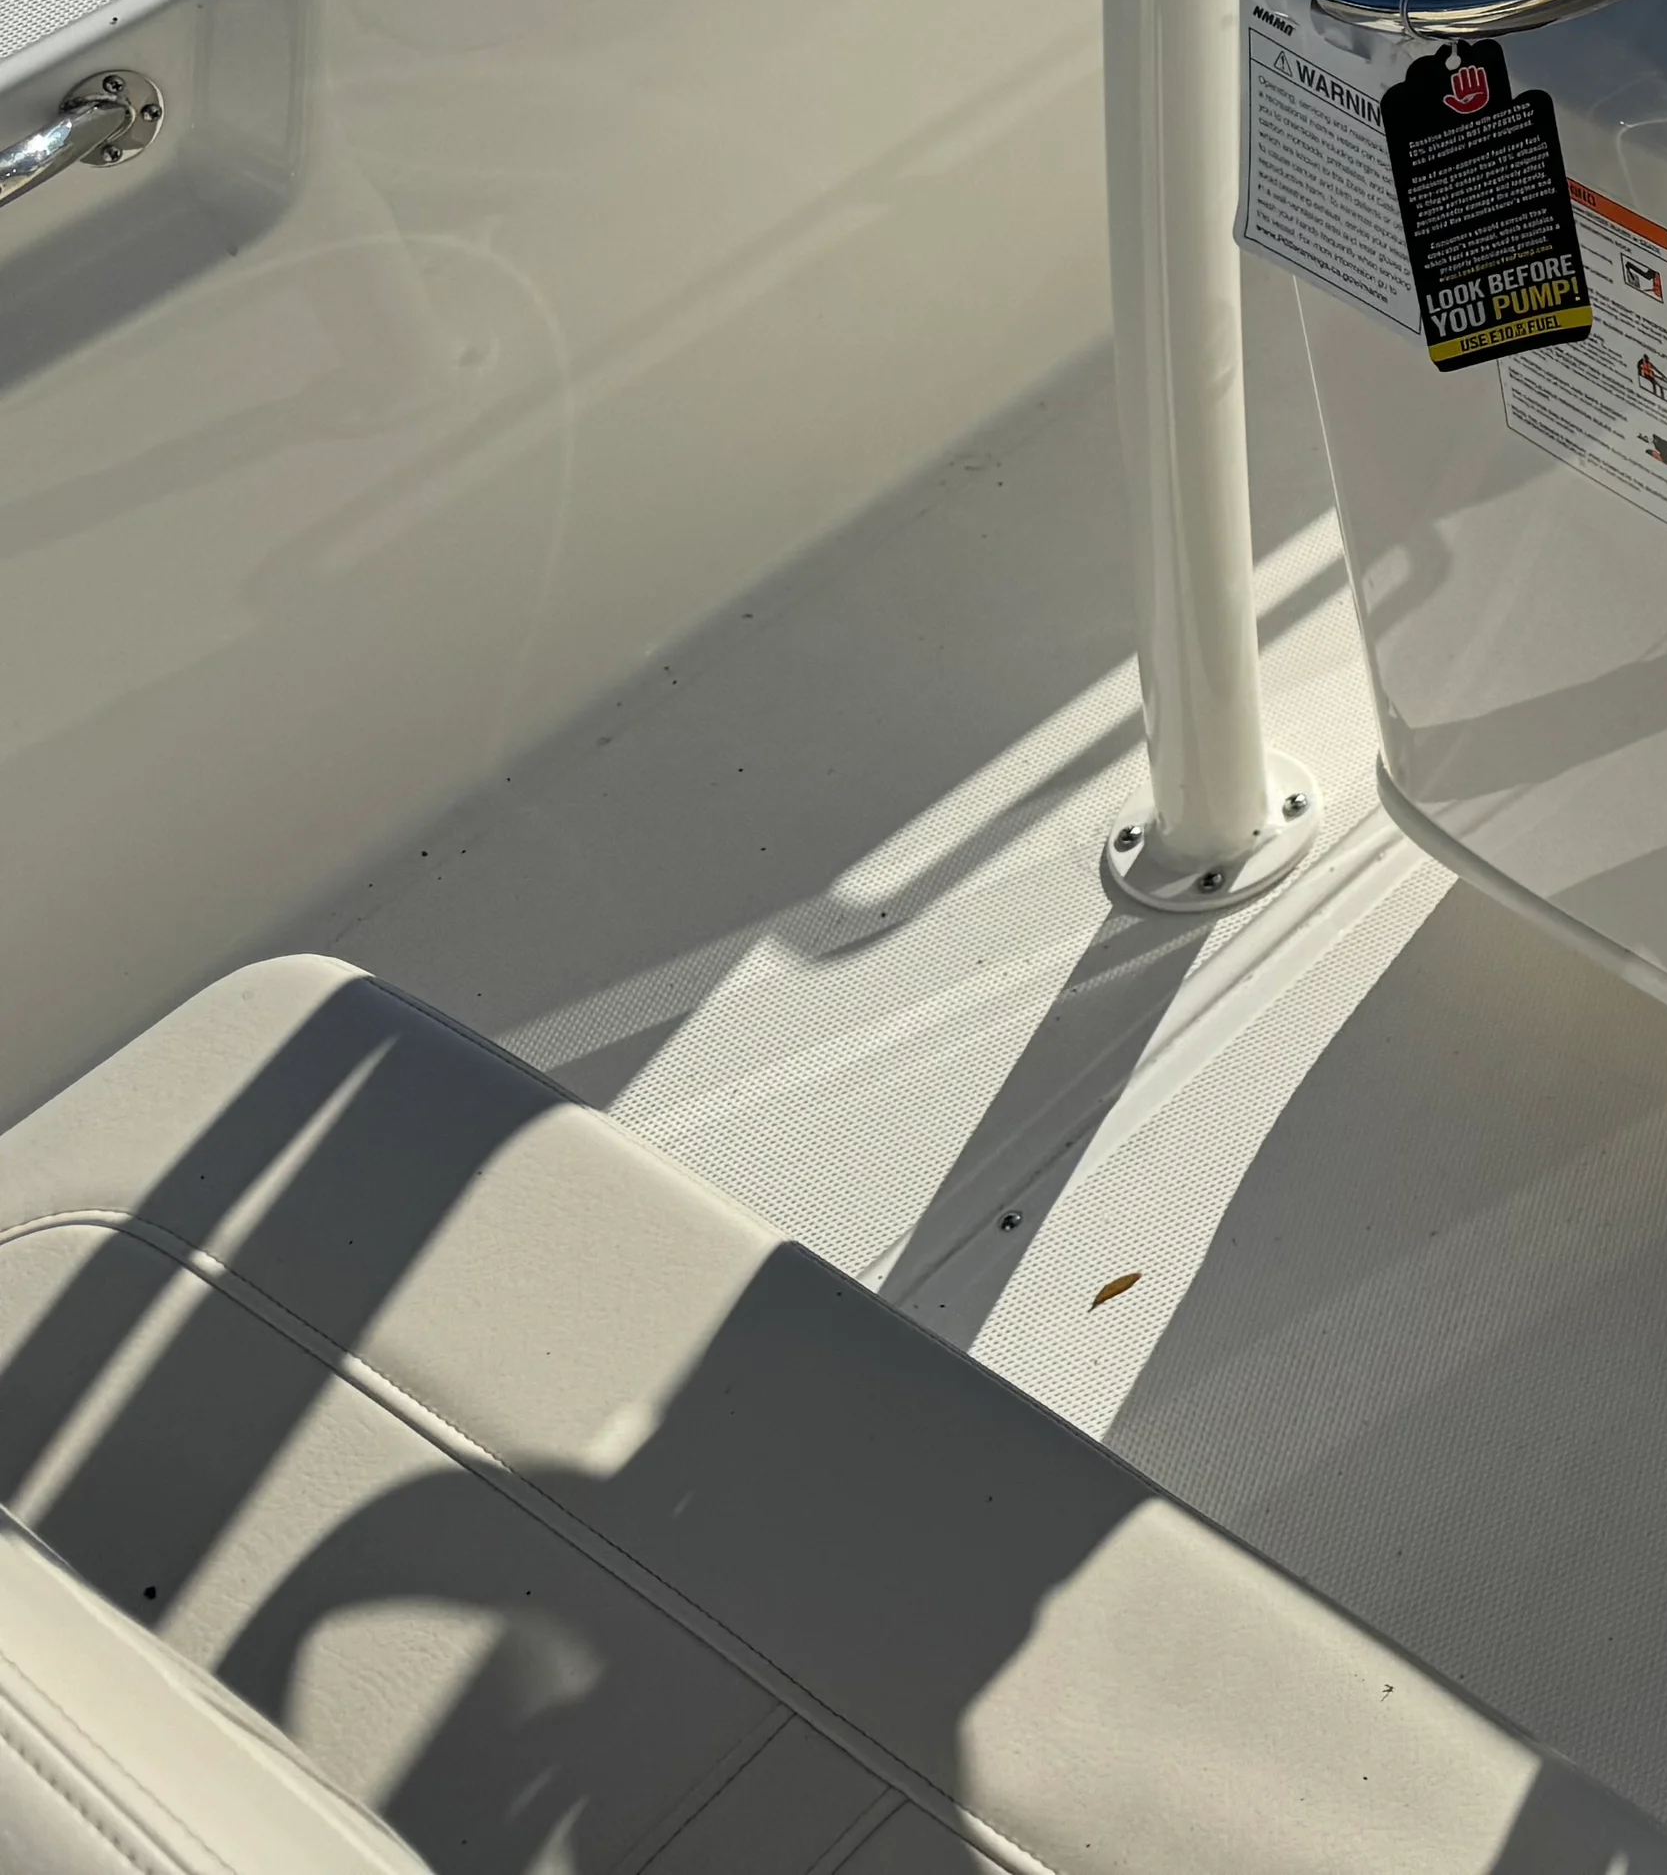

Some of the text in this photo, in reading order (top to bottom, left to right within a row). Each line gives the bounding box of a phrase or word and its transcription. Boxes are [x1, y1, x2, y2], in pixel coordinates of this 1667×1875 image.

[1296, 60, 1381, 127] WARNIN
[1426, 254, 1576, 314] LOOK BEFORE
[1431, 276, 1581, 338] YOU PUMP!
[1460, 334, 1488, 352] USE
[1489, 327, 1513, 344] E10
[1528, 315, 1561, 333] FUEL
